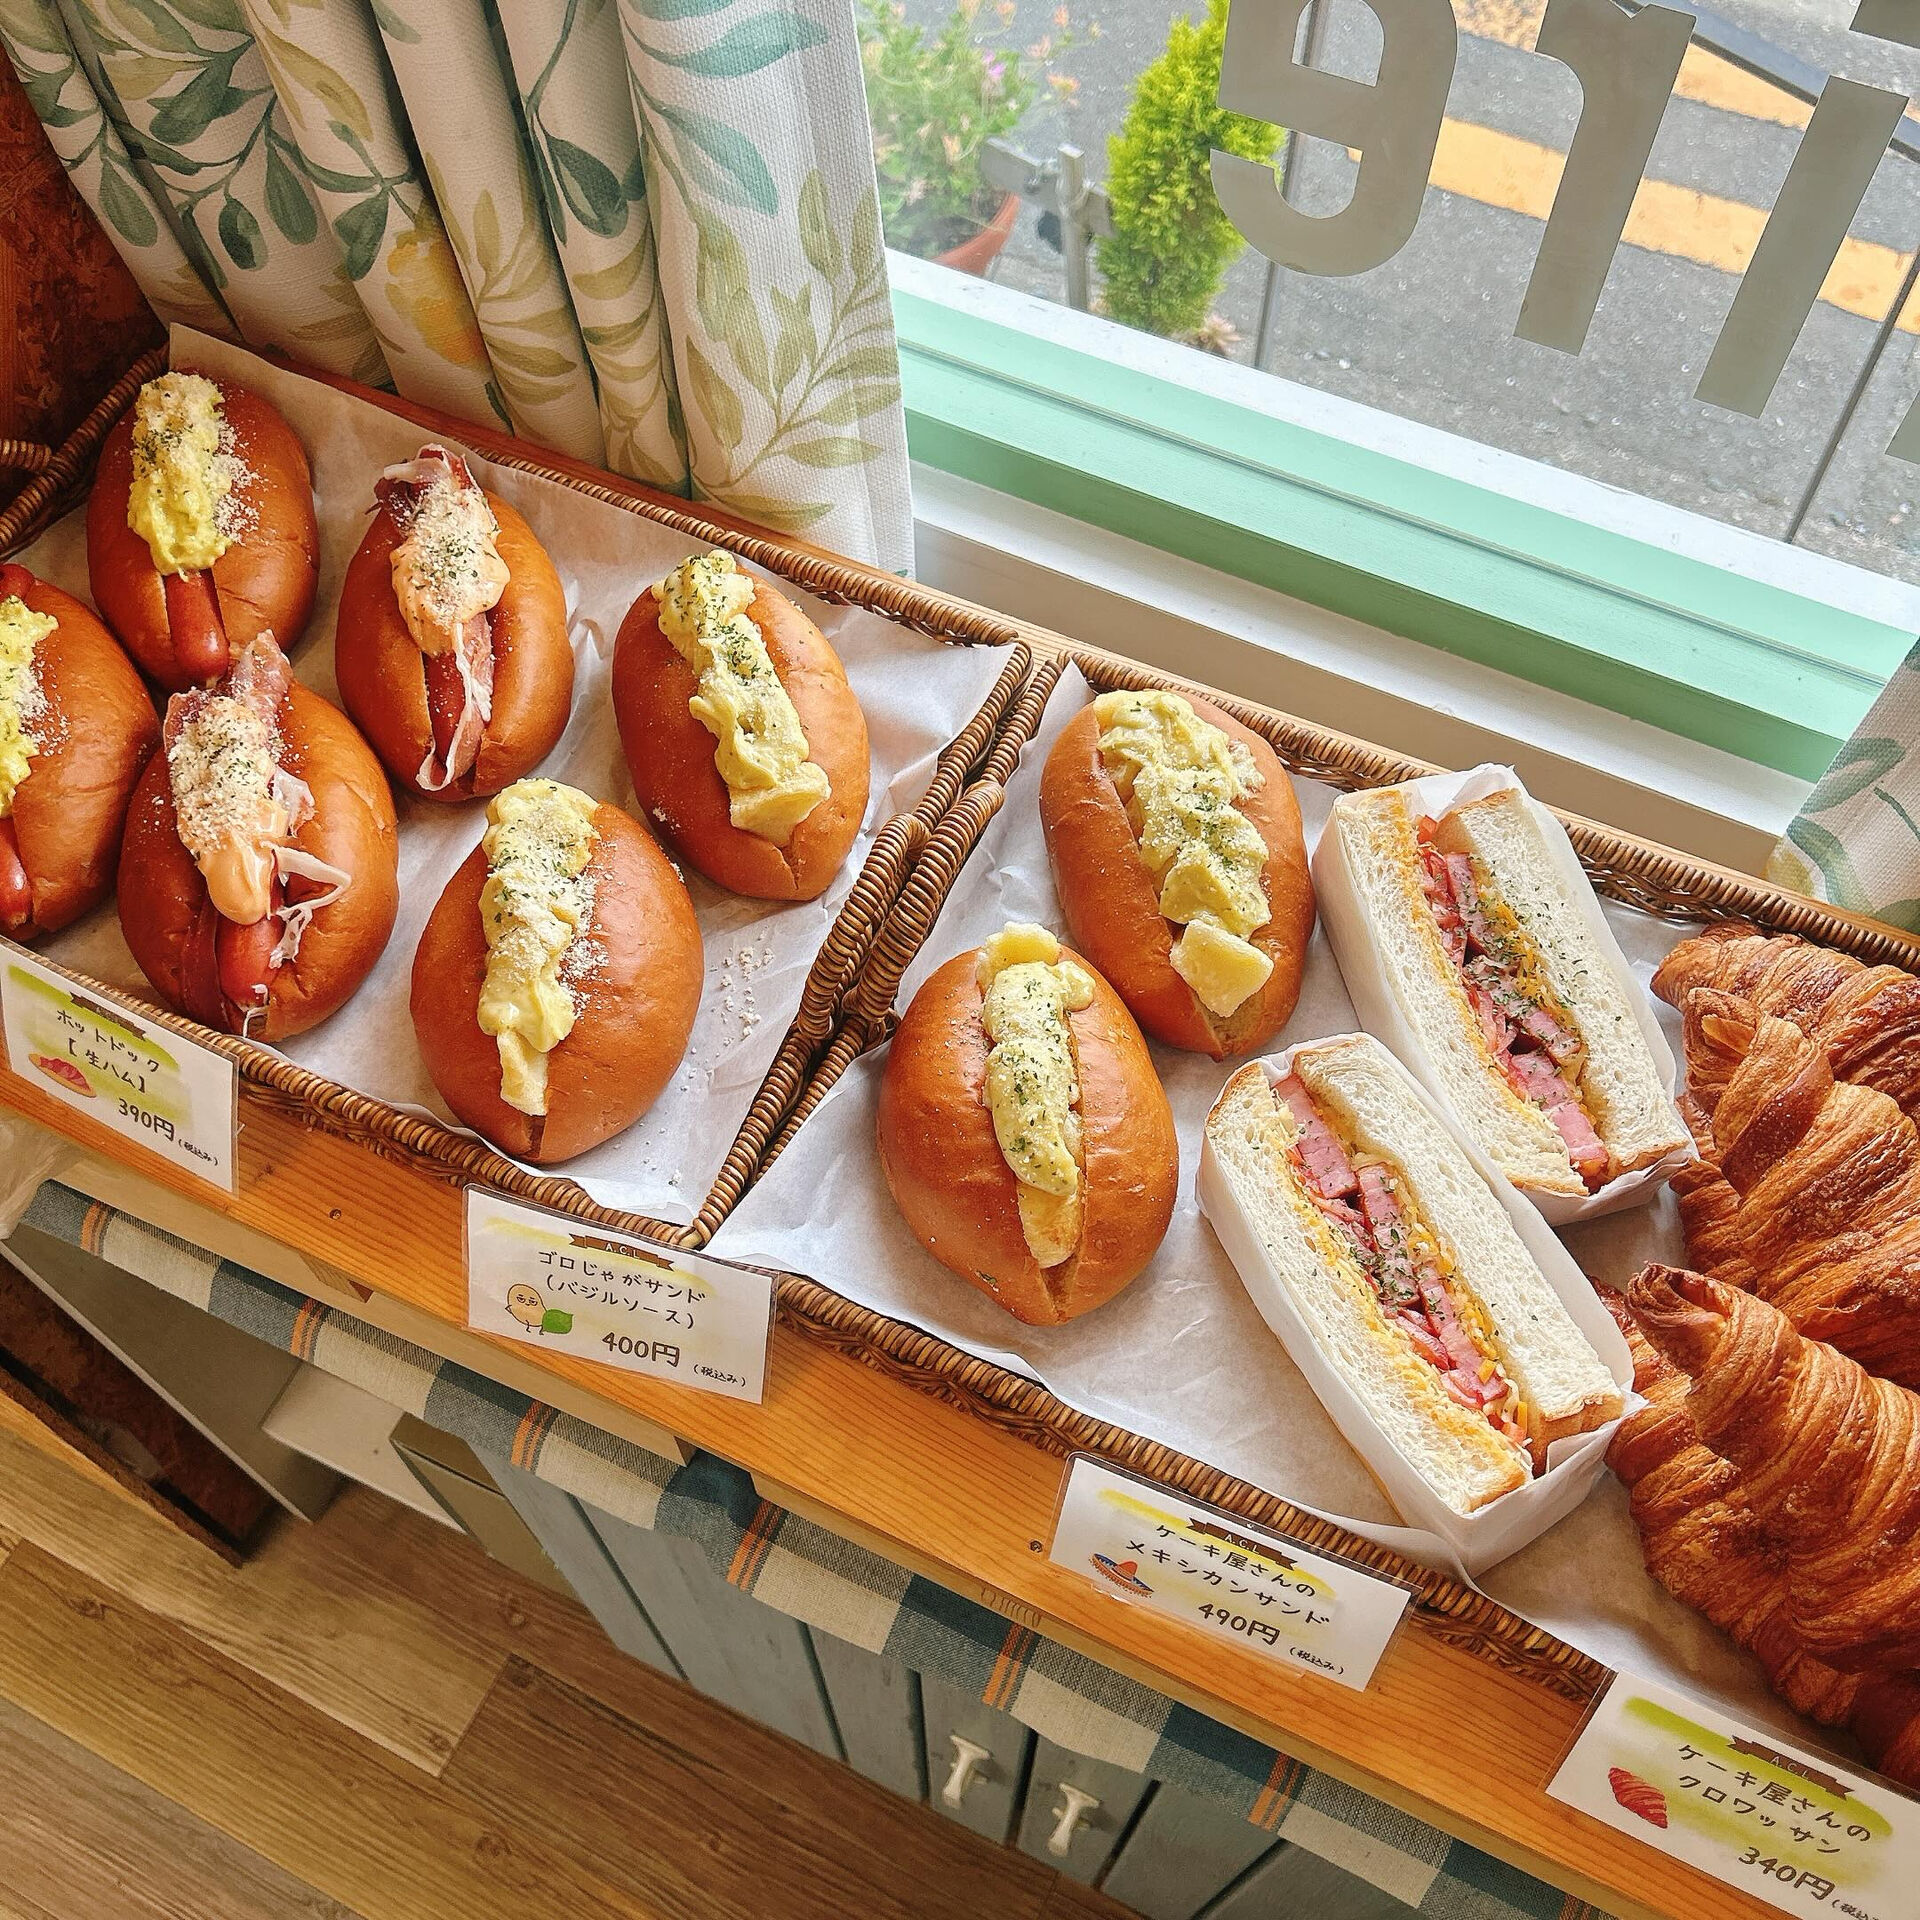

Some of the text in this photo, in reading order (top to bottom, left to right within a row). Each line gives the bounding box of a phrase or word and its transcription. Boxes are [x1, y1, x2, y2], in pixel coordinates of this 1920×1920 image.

[57, 1009, 160, 1073] ホットドック
[117, 1097, 175, 1142] 390円
[538, 1249, 706, 1304] ゴロじゃがサンド
[601, 1331, 681, 1367] 400円
[1125, 1539, 1330, 1626] メキシカンサンド
[1155, 1523, 1317, 1598] ケーキ屋さんの
[1197, 1602, 1282, 1647] 490円
[1677, 1773, 1842, 1855] クロワッサン
[1678, 1743, 1871, 1843] ケーキ屋さんの
[1737, 1846, 1836, 1901] 340円
